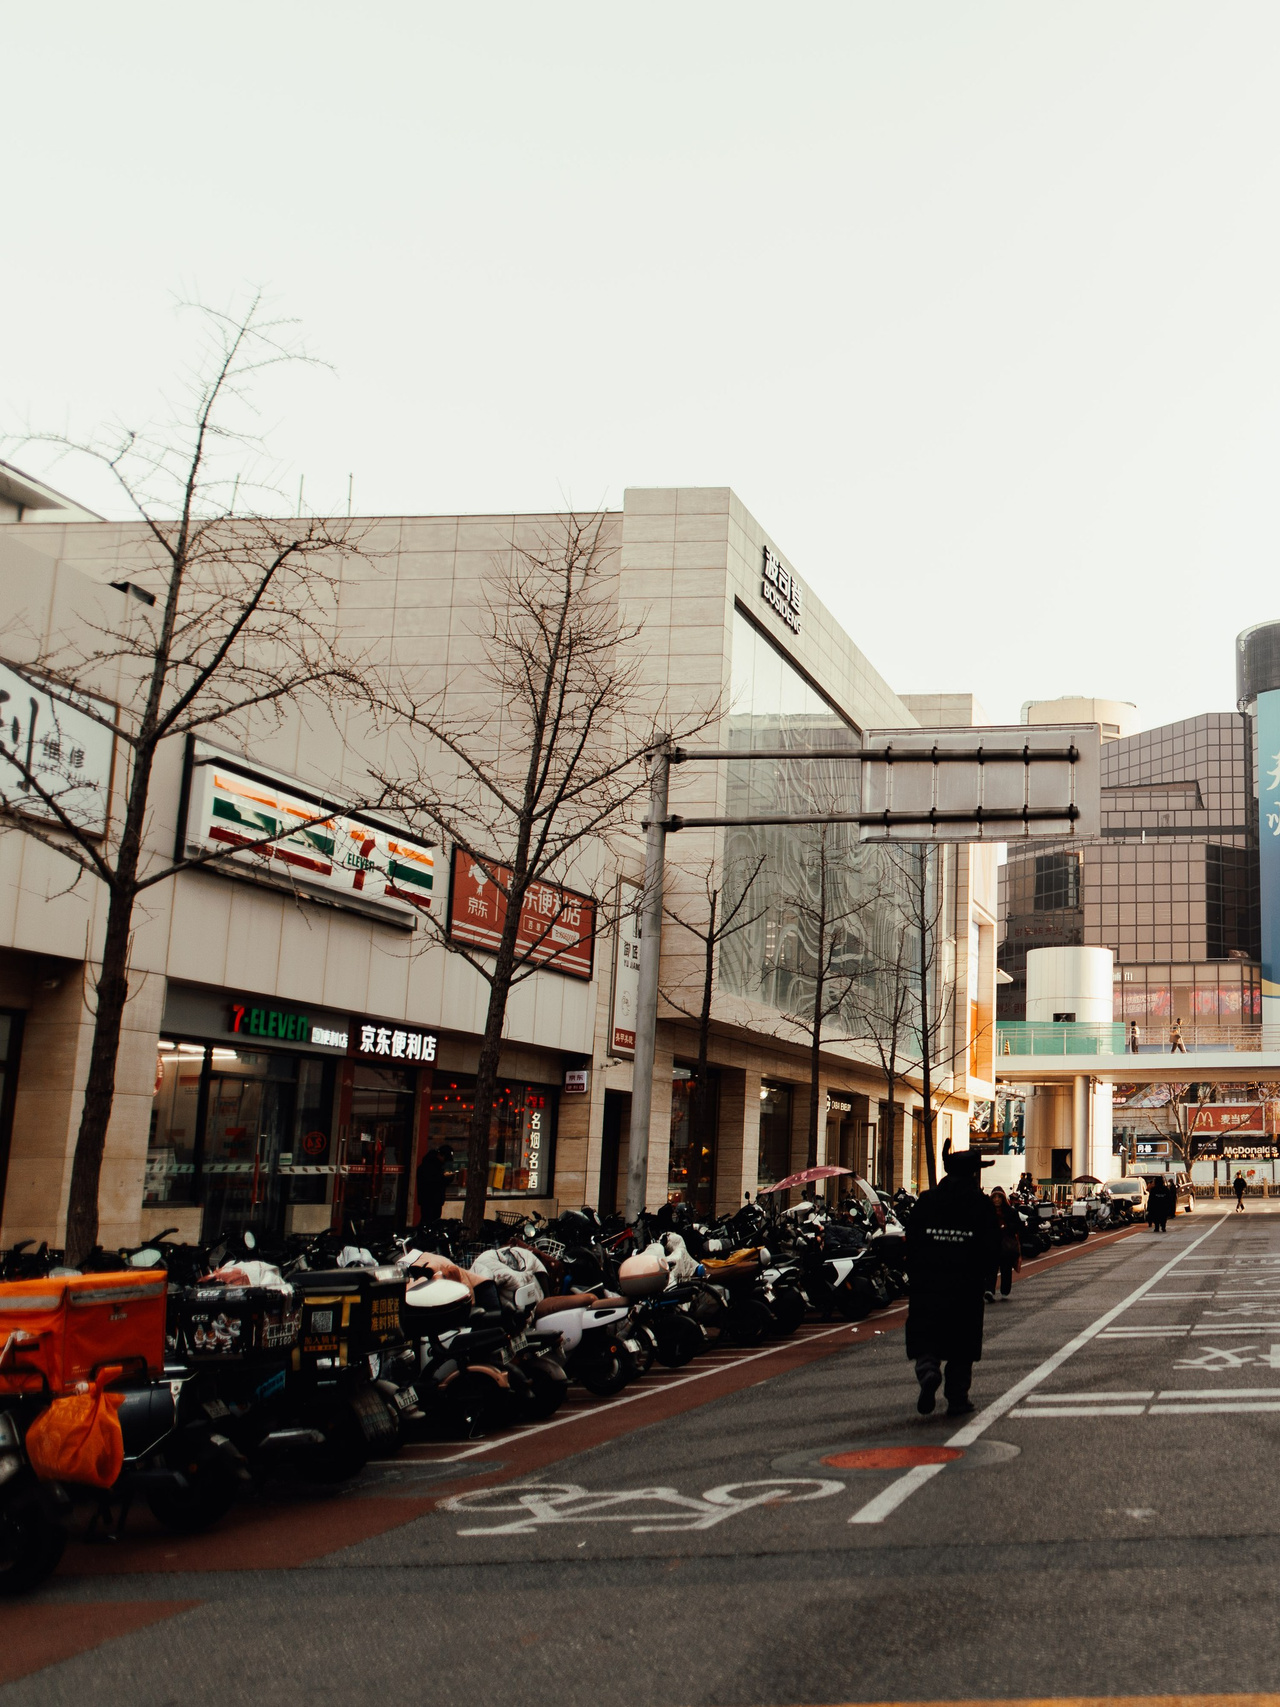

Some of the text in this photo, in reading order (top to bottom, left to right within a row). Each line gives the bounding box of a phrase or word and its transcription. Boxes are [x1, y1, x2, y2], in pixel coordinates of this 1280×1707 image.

[763, 545, 802, 615] 波司登
[762, 580, 802, 635] BOSIDENG
[467, 896, 489, 920] 京东
[507, 874, 583, 928] 东便利店
[360, 1024, 438, 1063] 京东便利店
[1221, 1114, 1250, 1125] 麦当劳
[528, 1112, 541, 1189] 名烟名酒
